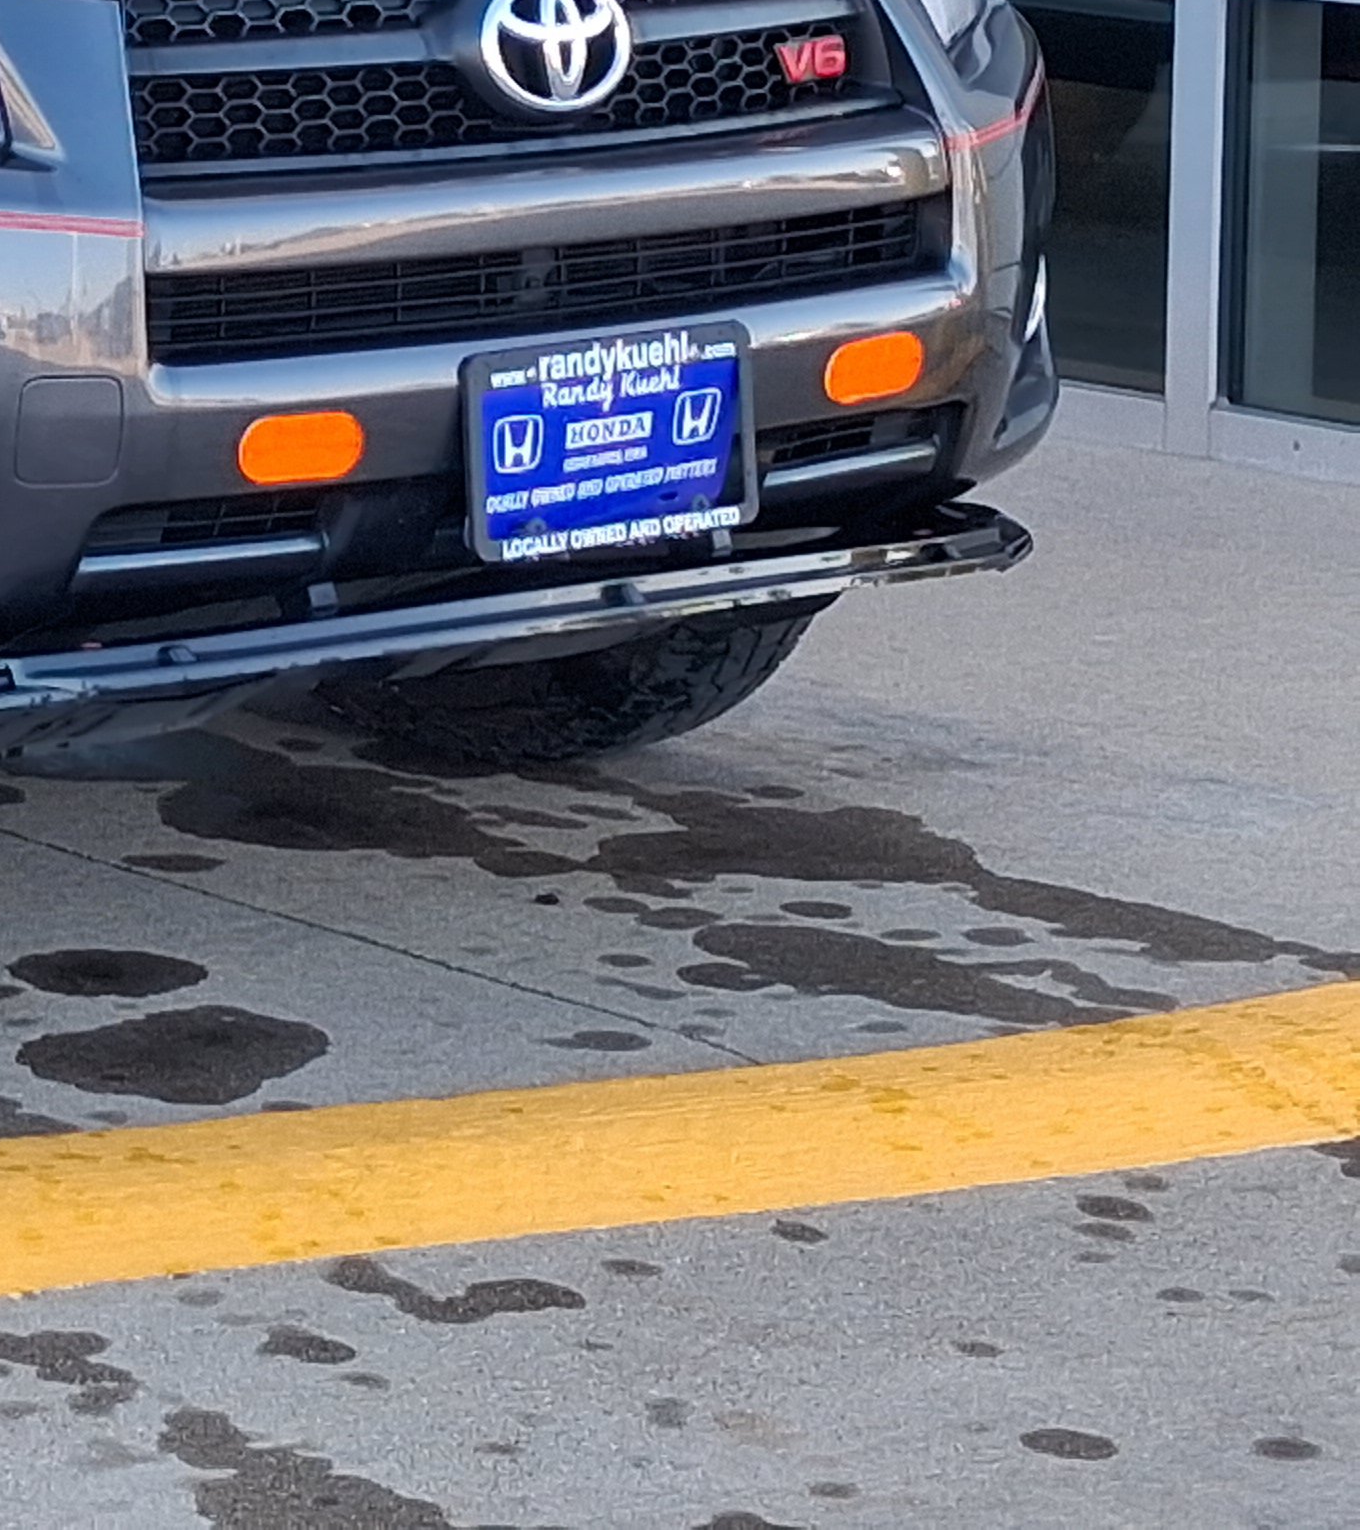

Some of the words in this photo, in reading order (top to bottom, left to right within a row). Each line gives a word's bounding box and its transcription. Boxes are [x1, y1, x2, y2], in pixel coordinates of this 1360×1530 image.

[778, 33, 846, 84] V6
[541, 376, 614, 412] Randy
[620, 366, 680, 398] Kuehl
[569, 417, 646, 444] HONDA
[502, 530, 569, 561] LOCALLY
[570, 523, 627, 550] OWNED
[629, 516, 661, 541] AND
[663, 505, 739, 533] OPERATED
